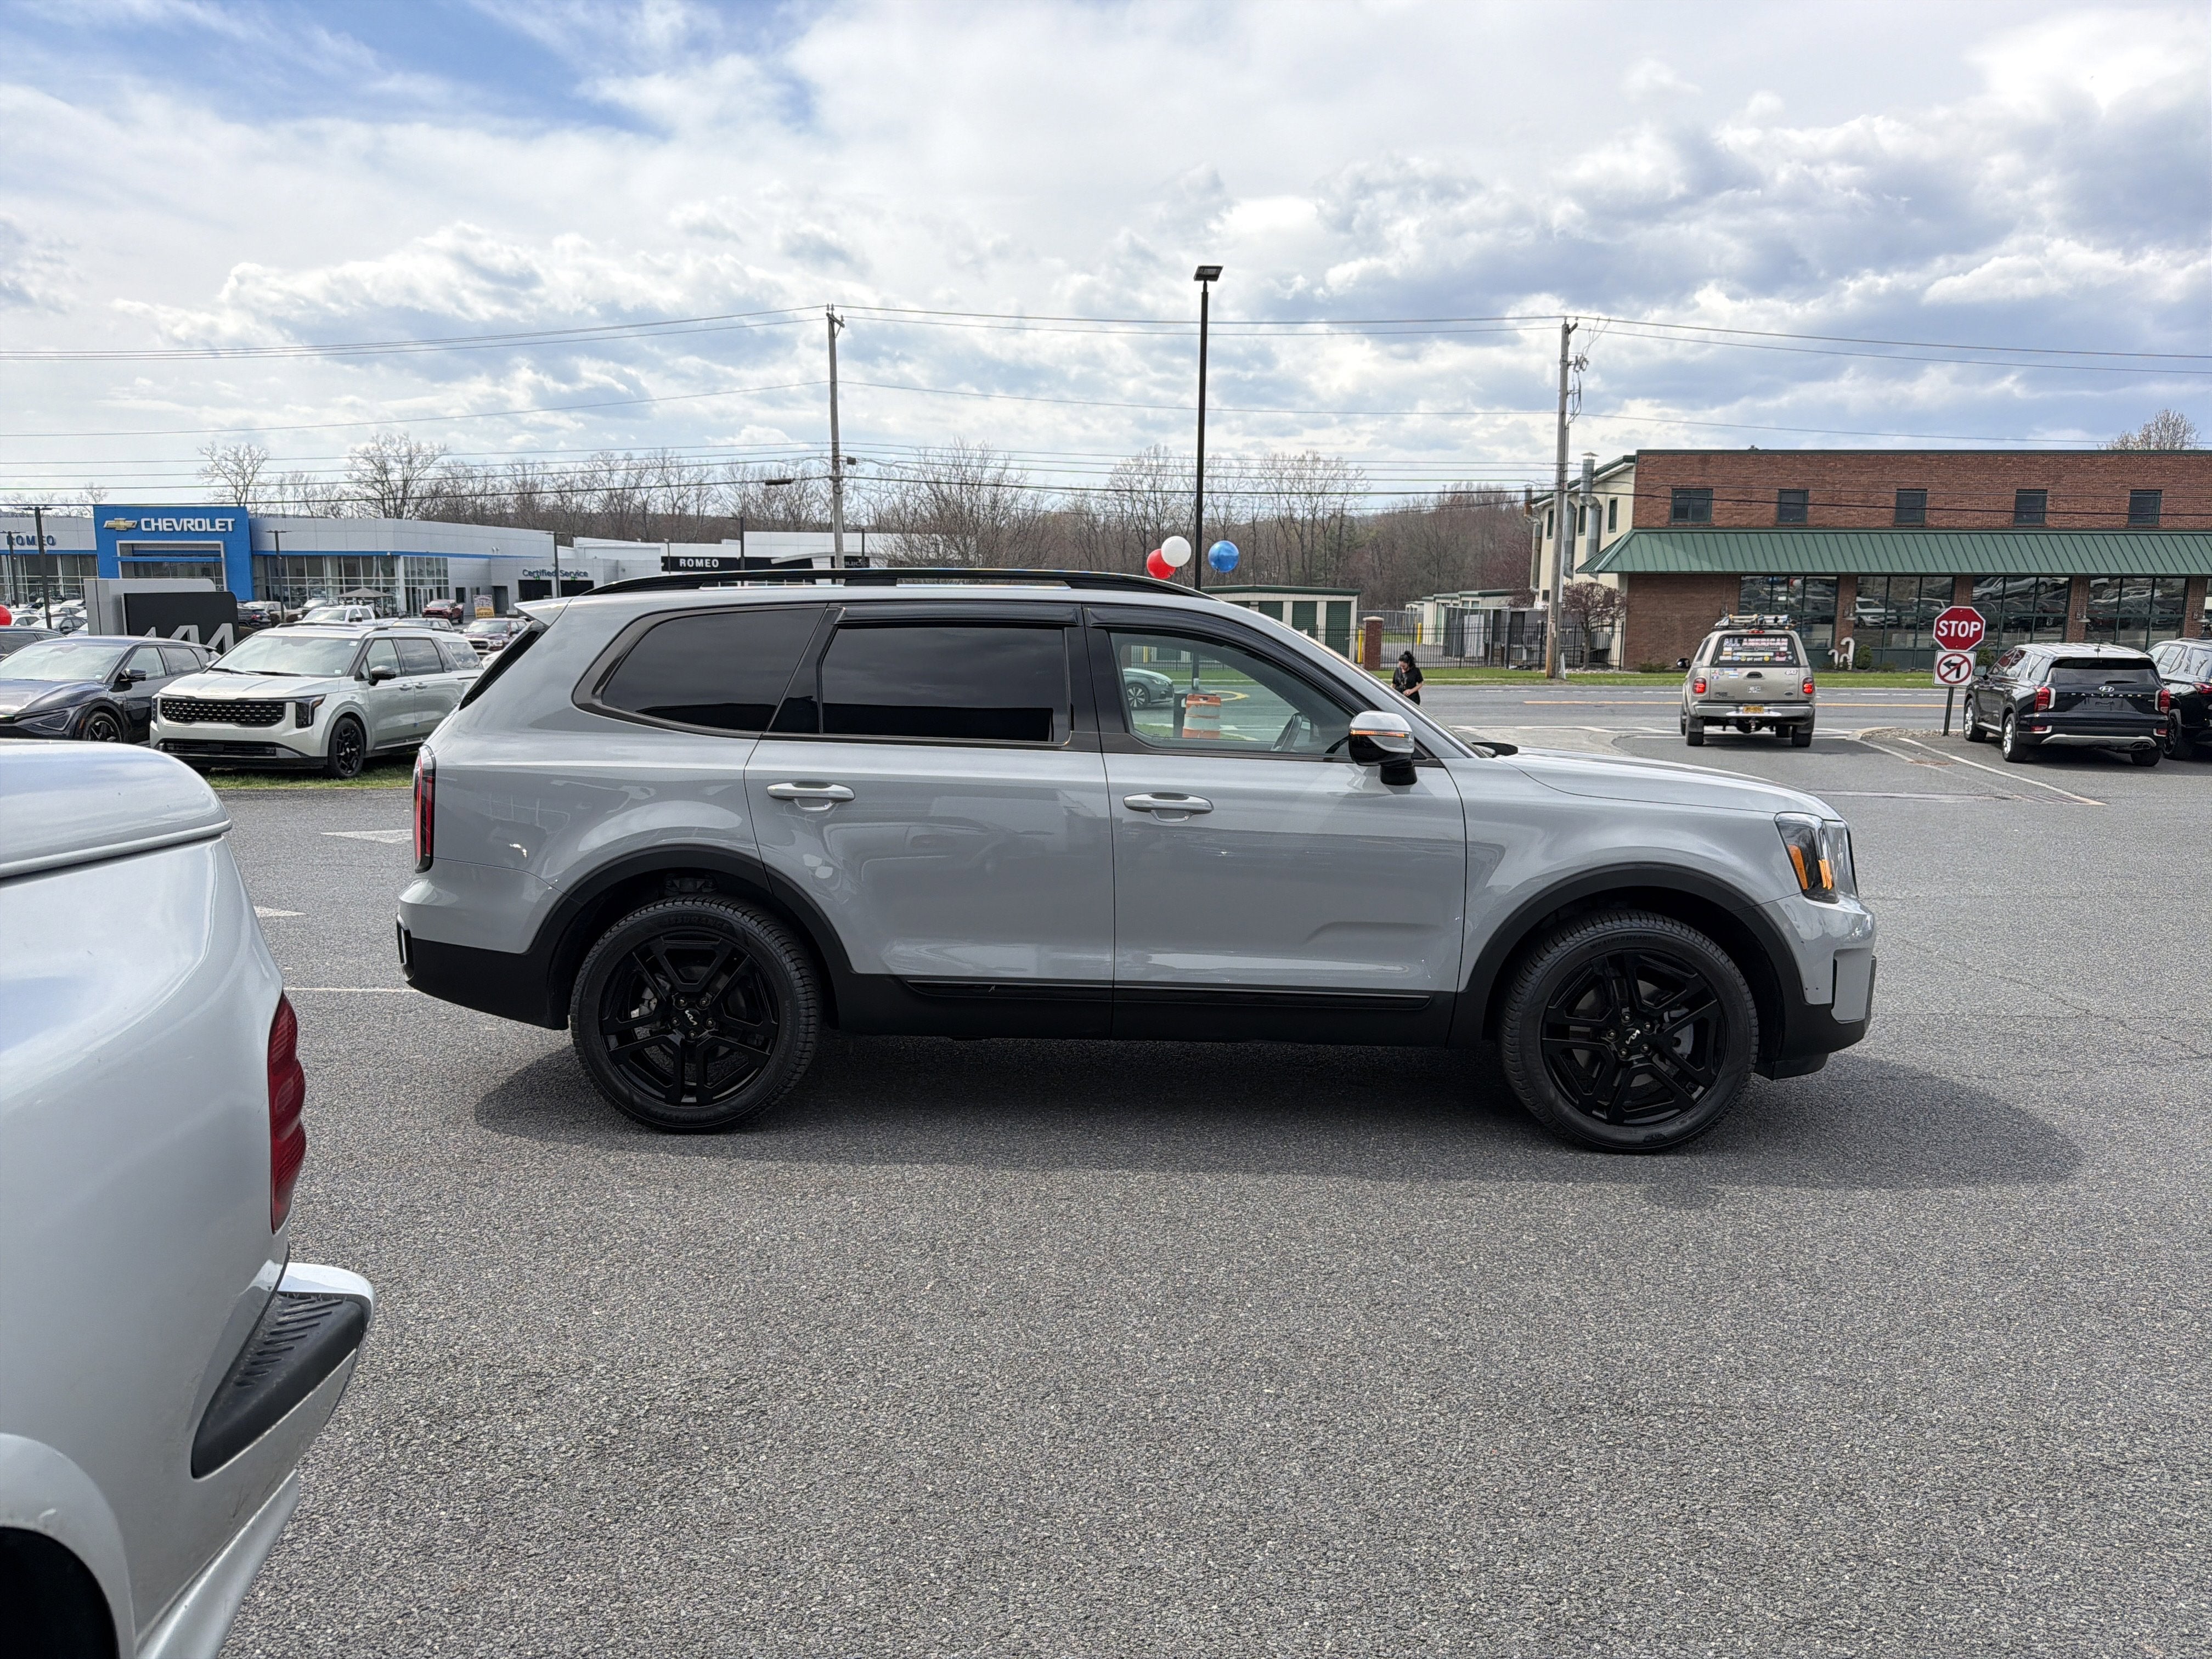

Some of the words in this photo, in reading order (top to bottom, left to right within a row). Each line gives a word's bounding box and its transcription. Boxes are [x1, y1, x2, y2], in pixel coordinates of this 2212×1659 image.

[140, 518, 235, 532] CHEVROLET
[679, 558, 719, 568] ROMEO
[522, 569, 556, 577] Certified
[1937, 620, 1981, 638] STOP
